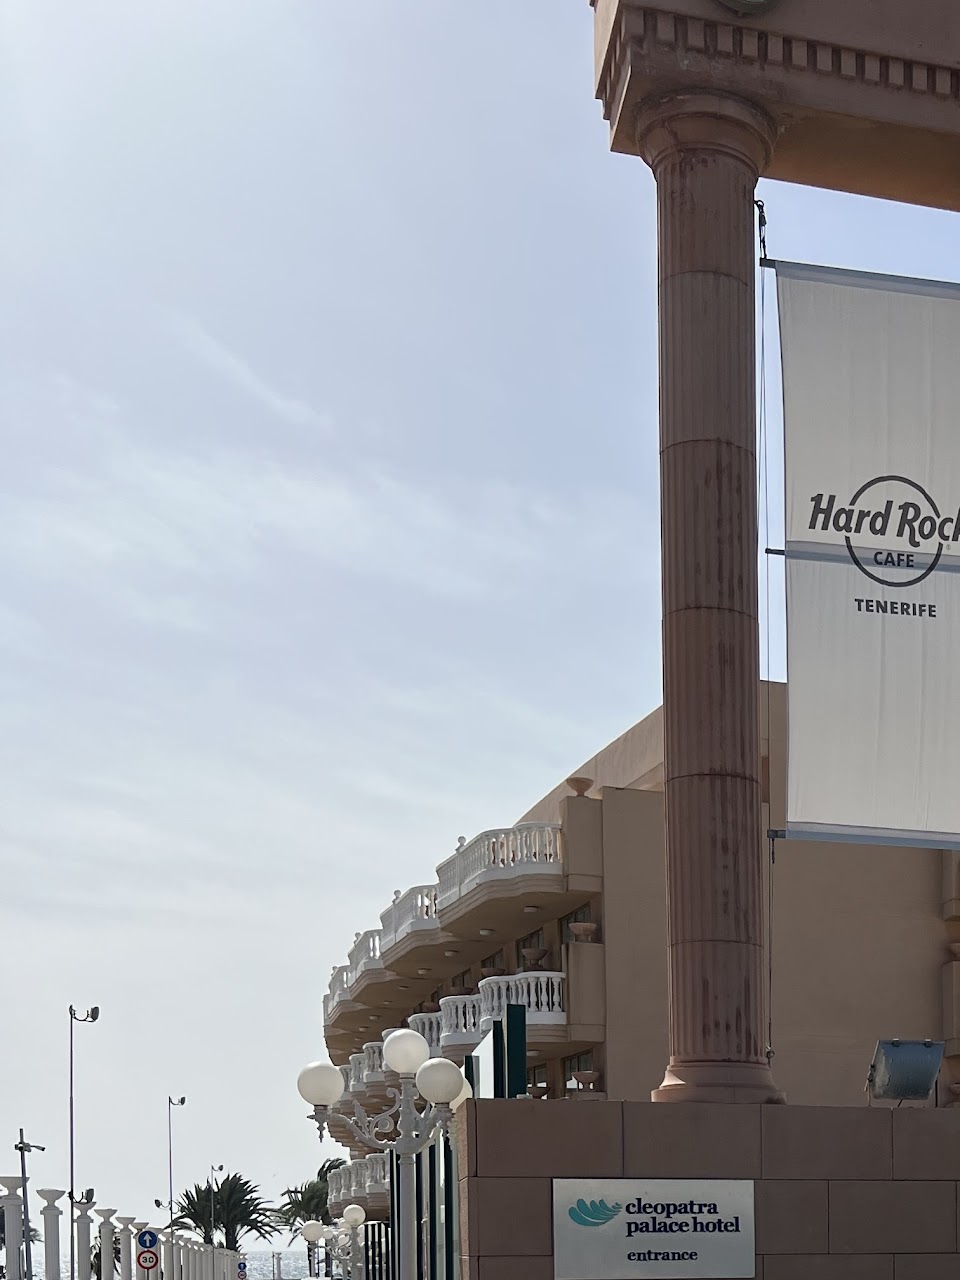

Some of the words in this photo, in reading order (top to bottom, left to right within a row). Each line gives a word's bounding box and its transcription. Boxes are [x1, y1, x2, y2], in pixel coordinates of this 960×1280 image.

[808, 493, 893, 536] Hard
[873, 551, 915, 568] CAFE
[854, 598, 937, 618] TENERIFE
[625, 1198, 719, 1219] cleopatra
[625, 1216, 690, 1237] palace
[692, 1216, 741, 1233] hotel
[141, 1256, 155, 1264] 30
[627, 1249, 698, 1262] entrance
